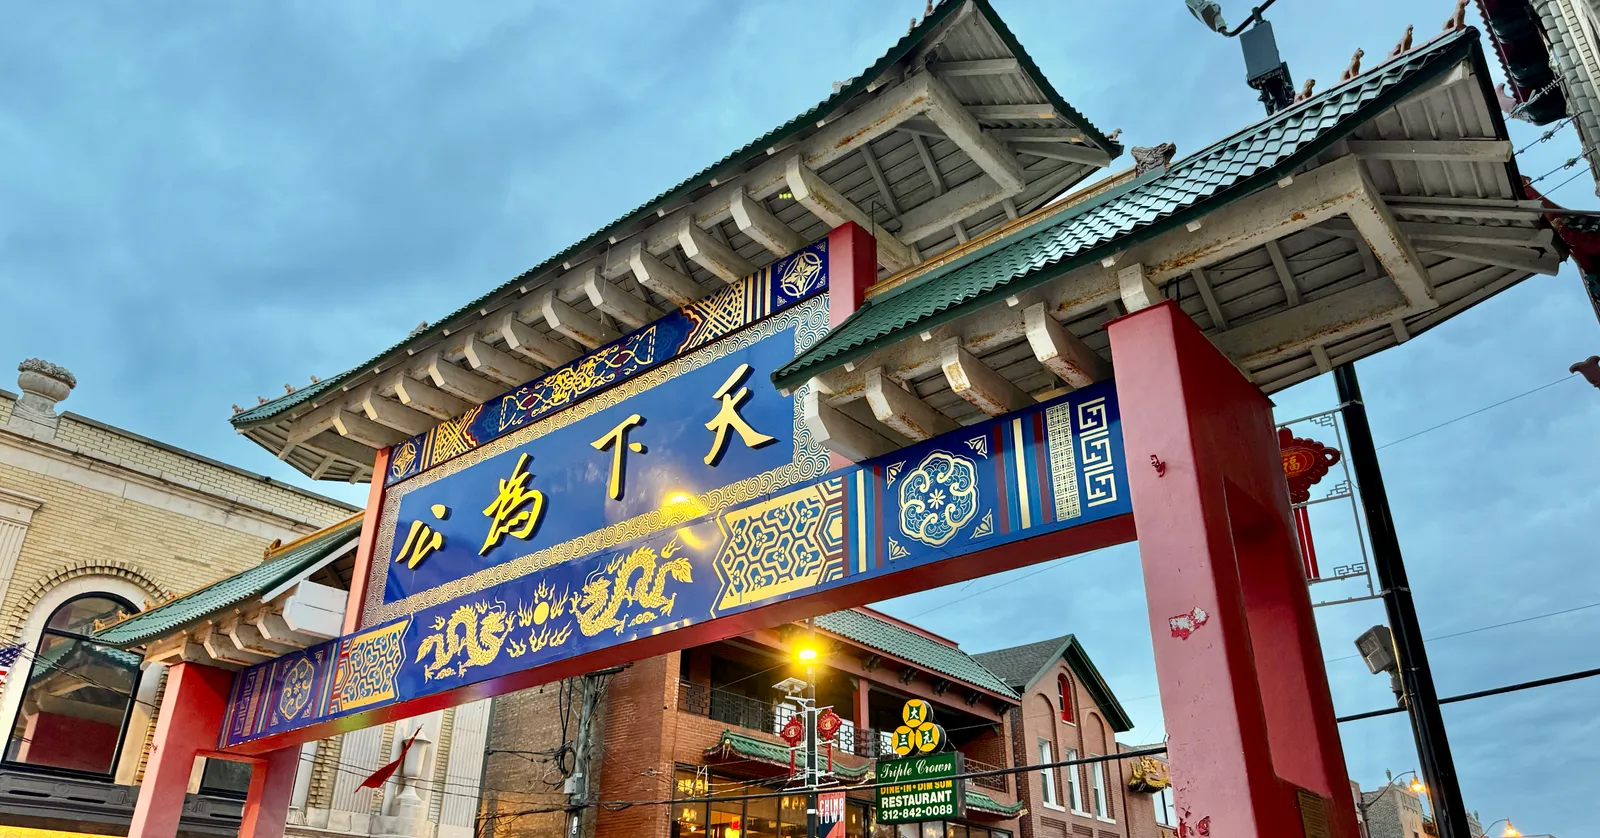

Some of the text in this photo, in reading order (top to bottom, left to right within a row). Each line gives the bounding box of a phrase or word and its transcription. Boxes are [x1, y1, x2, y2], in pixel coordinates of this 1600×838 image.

[880, 759, 952, 783] Triple Crown
[917, 781, 933, 791] DIM
[934, 780, 953, 789] SUM
[820, 797, 844, 812] CHINA
[881, 790, 952, 808] RESTAURANT
[819, 809, 844, 824] TOWN
[882, 804, 953, 820] 312-842-0088
